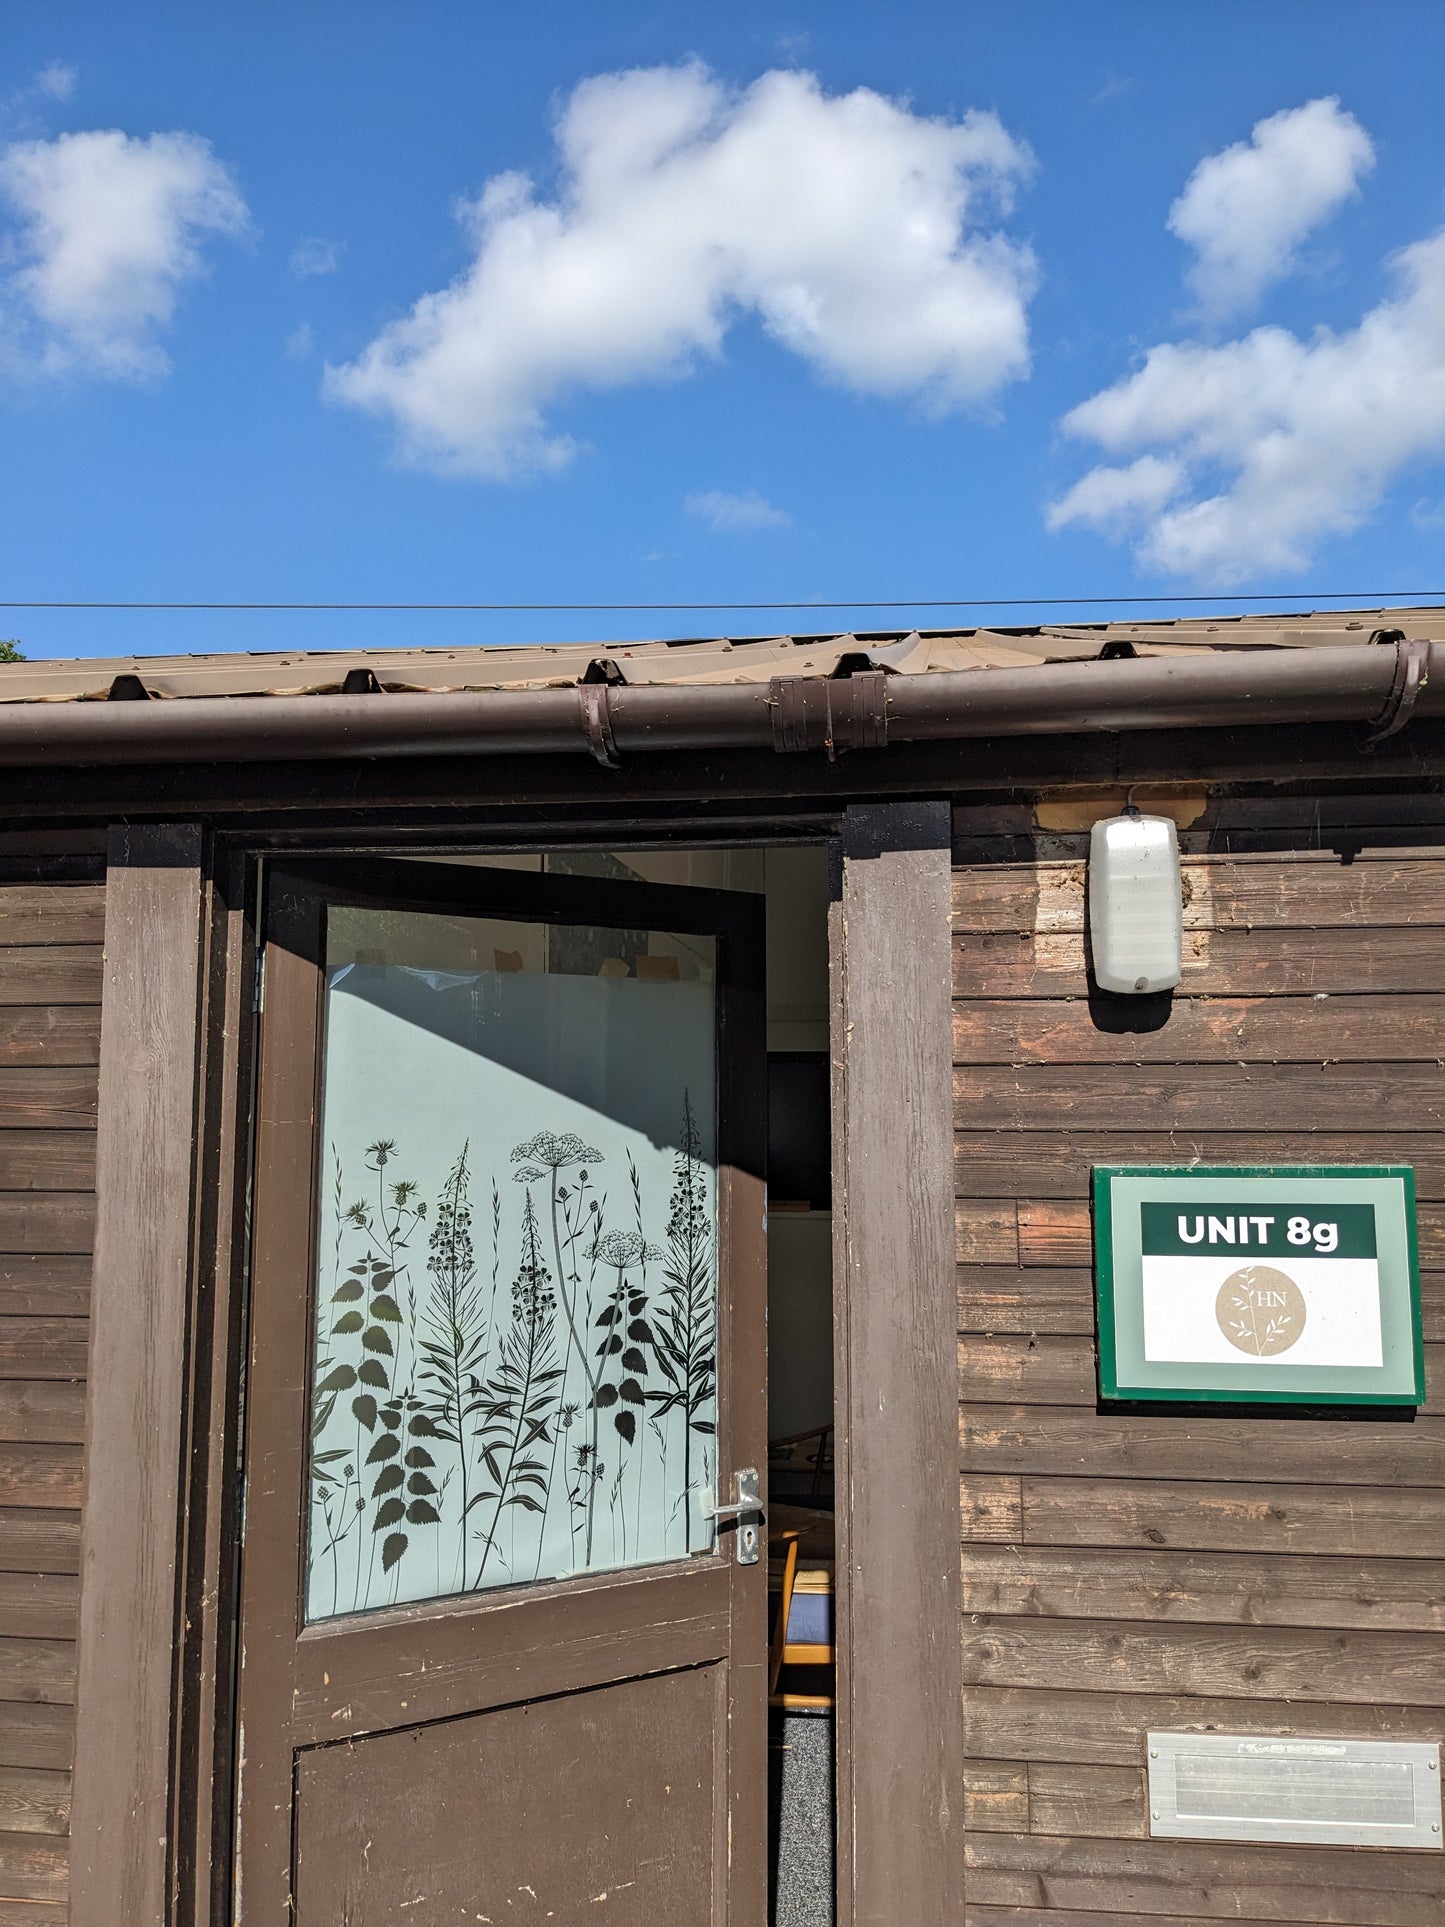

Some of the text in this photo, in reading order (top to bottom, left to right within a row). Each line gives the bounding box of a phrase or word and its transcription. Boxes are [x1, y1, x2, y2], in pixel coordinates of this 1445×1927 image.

[1177, 1215, 1339, 1252] UNIT 8g
[1256, 1291, 1287, 1308] HN
